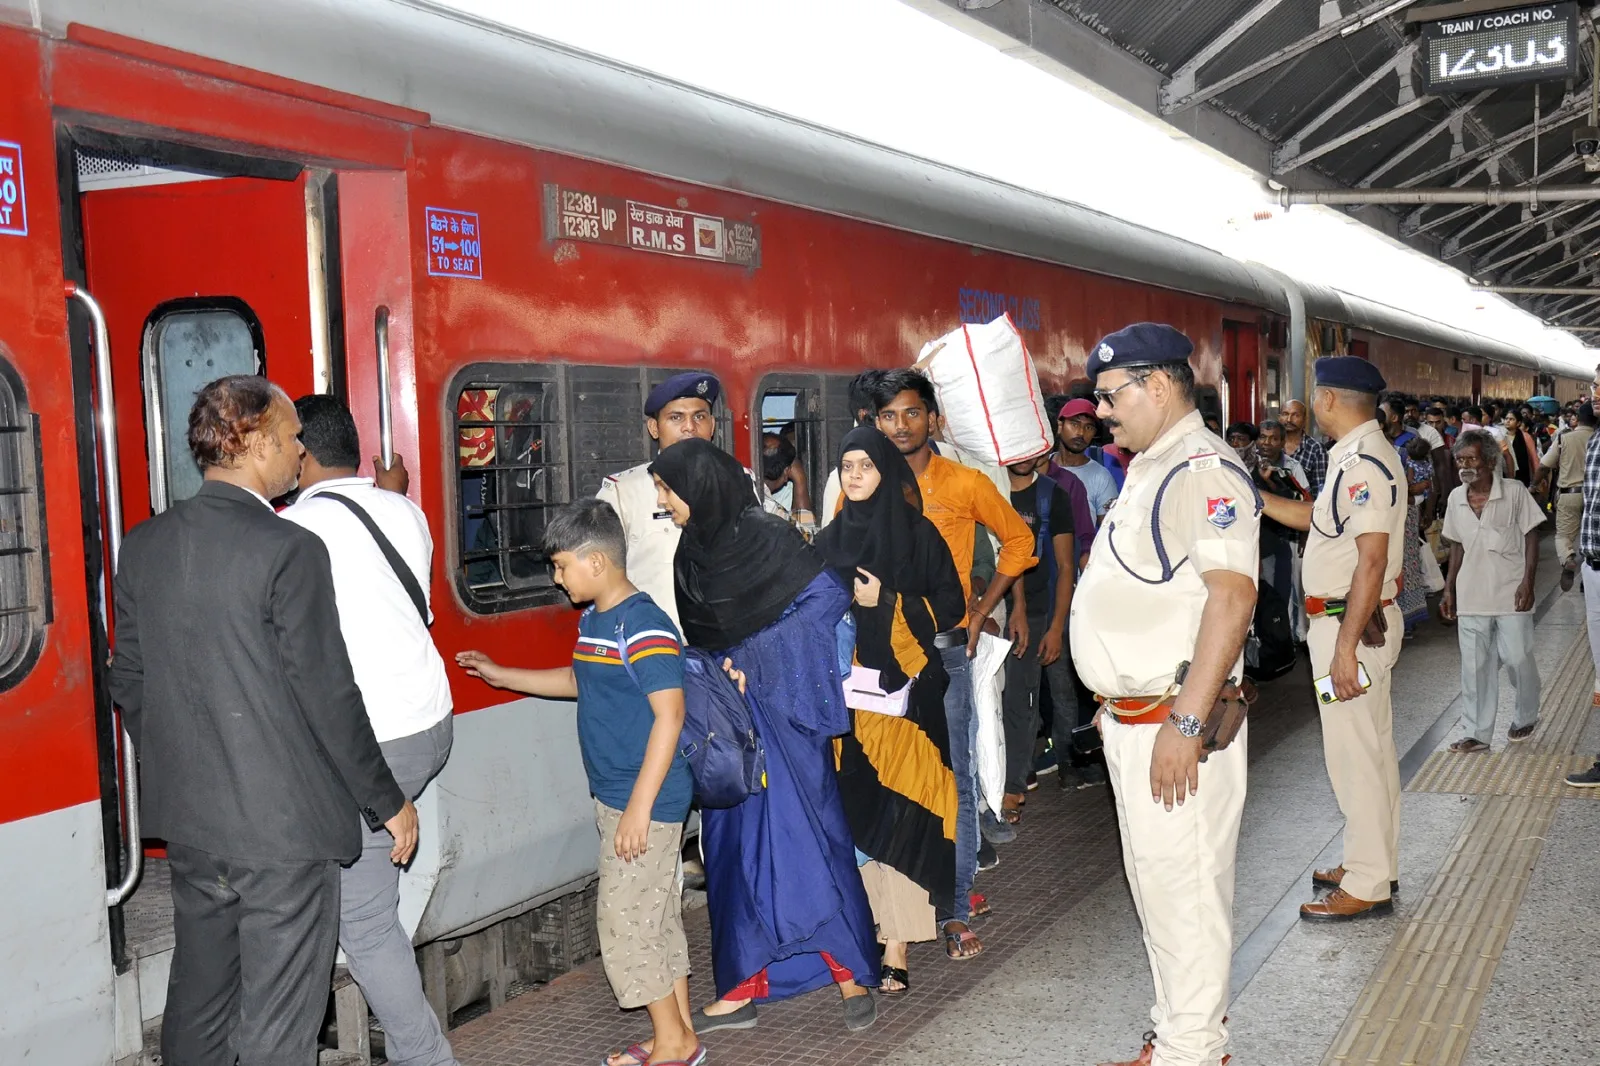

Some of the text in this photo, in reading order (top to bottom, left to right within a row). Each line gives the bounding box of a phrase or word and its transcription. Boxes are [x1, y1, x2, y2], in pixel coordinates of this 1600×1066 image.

[1441, 21, 1474, 35] TRAIN
[1483, 12, 1530, 29] COACH
[1532, 9, 1556, 21] NO.
[0, 178, 17, 205] 0
[563, 190, 598, 214] 12381
[431, 214, 475, 236] बैठने के लिए
[563, 207, 617, 239] 12303 UP
[630, 204, 684, 229] रेल डाक सेवा
[432, 235, 480, 258] 51 100
[632, 226, 687, 252] R.M.S
[437, 256, 475, 272] TO SEAT
[959, 287, 1040, 331] SECOND CLASS
